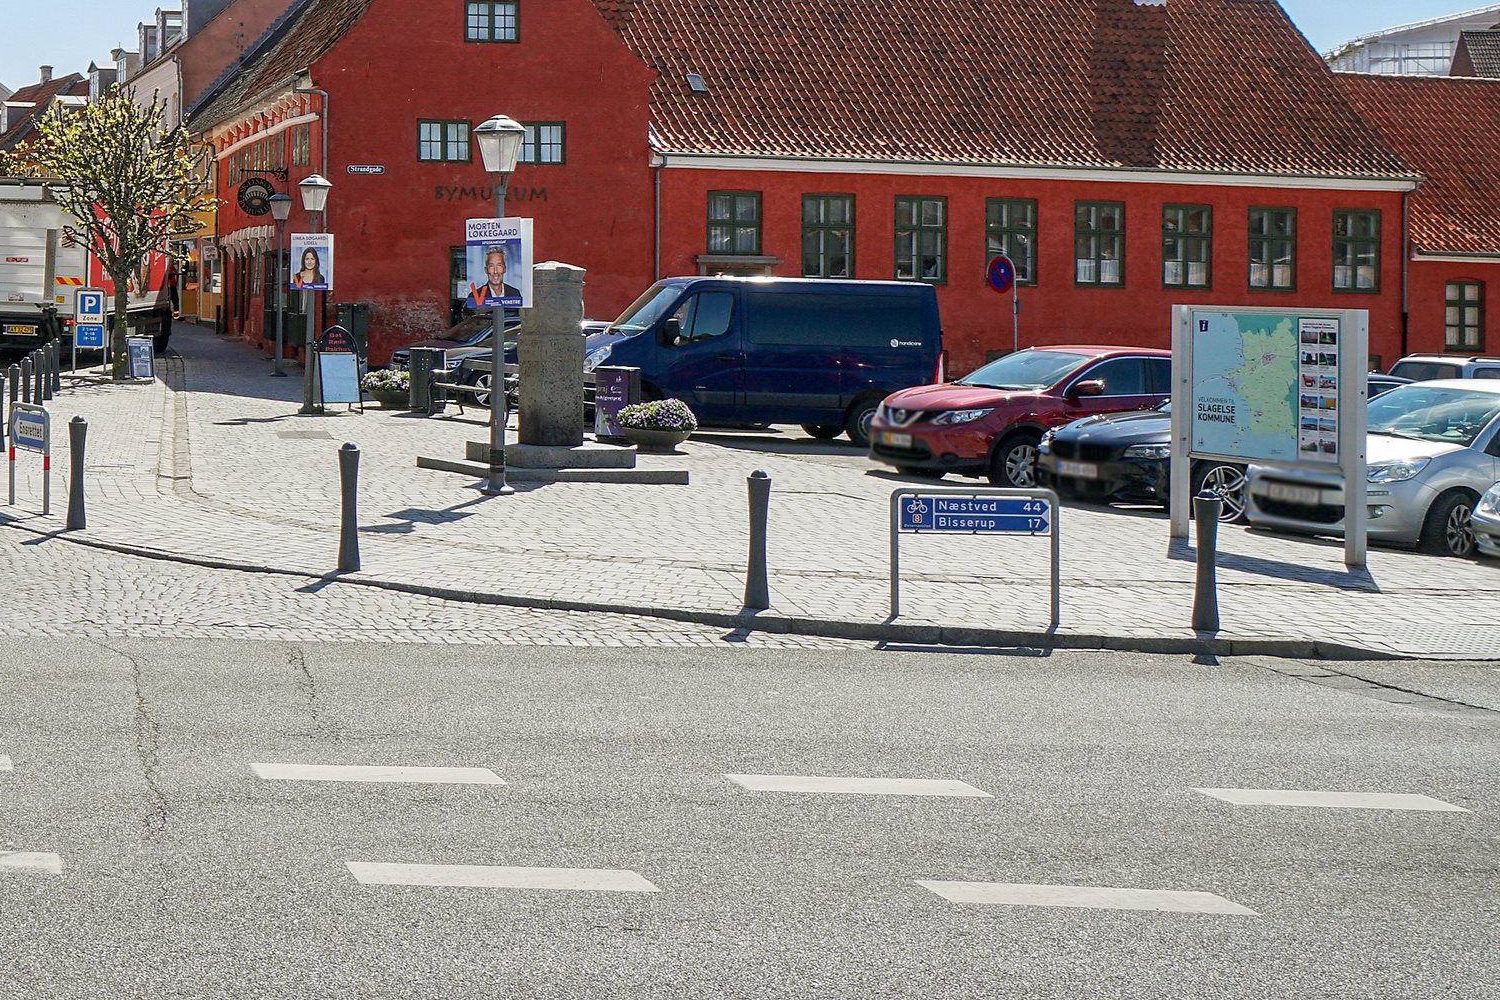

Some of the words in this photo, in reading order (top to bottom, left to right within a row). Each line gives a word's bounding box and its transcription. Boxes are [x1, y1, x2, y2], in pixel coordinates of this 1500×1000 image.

[350, 165, 383, 174] Strandgade
[468, 222, 501, 231] MORTEN
[468, 229, 518, 238] LØKKEGAARD
[1197, 403, 1236, 415] SLAGELSE
[1197, 412, 1236, 424] KOMMUNE
[19, 421, 43, 438] Ensrettet
[938, 500, 997, 512] Næstved
[1023, 502, 1041, 512] 44
[938, 516, 996, 530] Bisserup
[1027, 518, 1041, 528] 17
